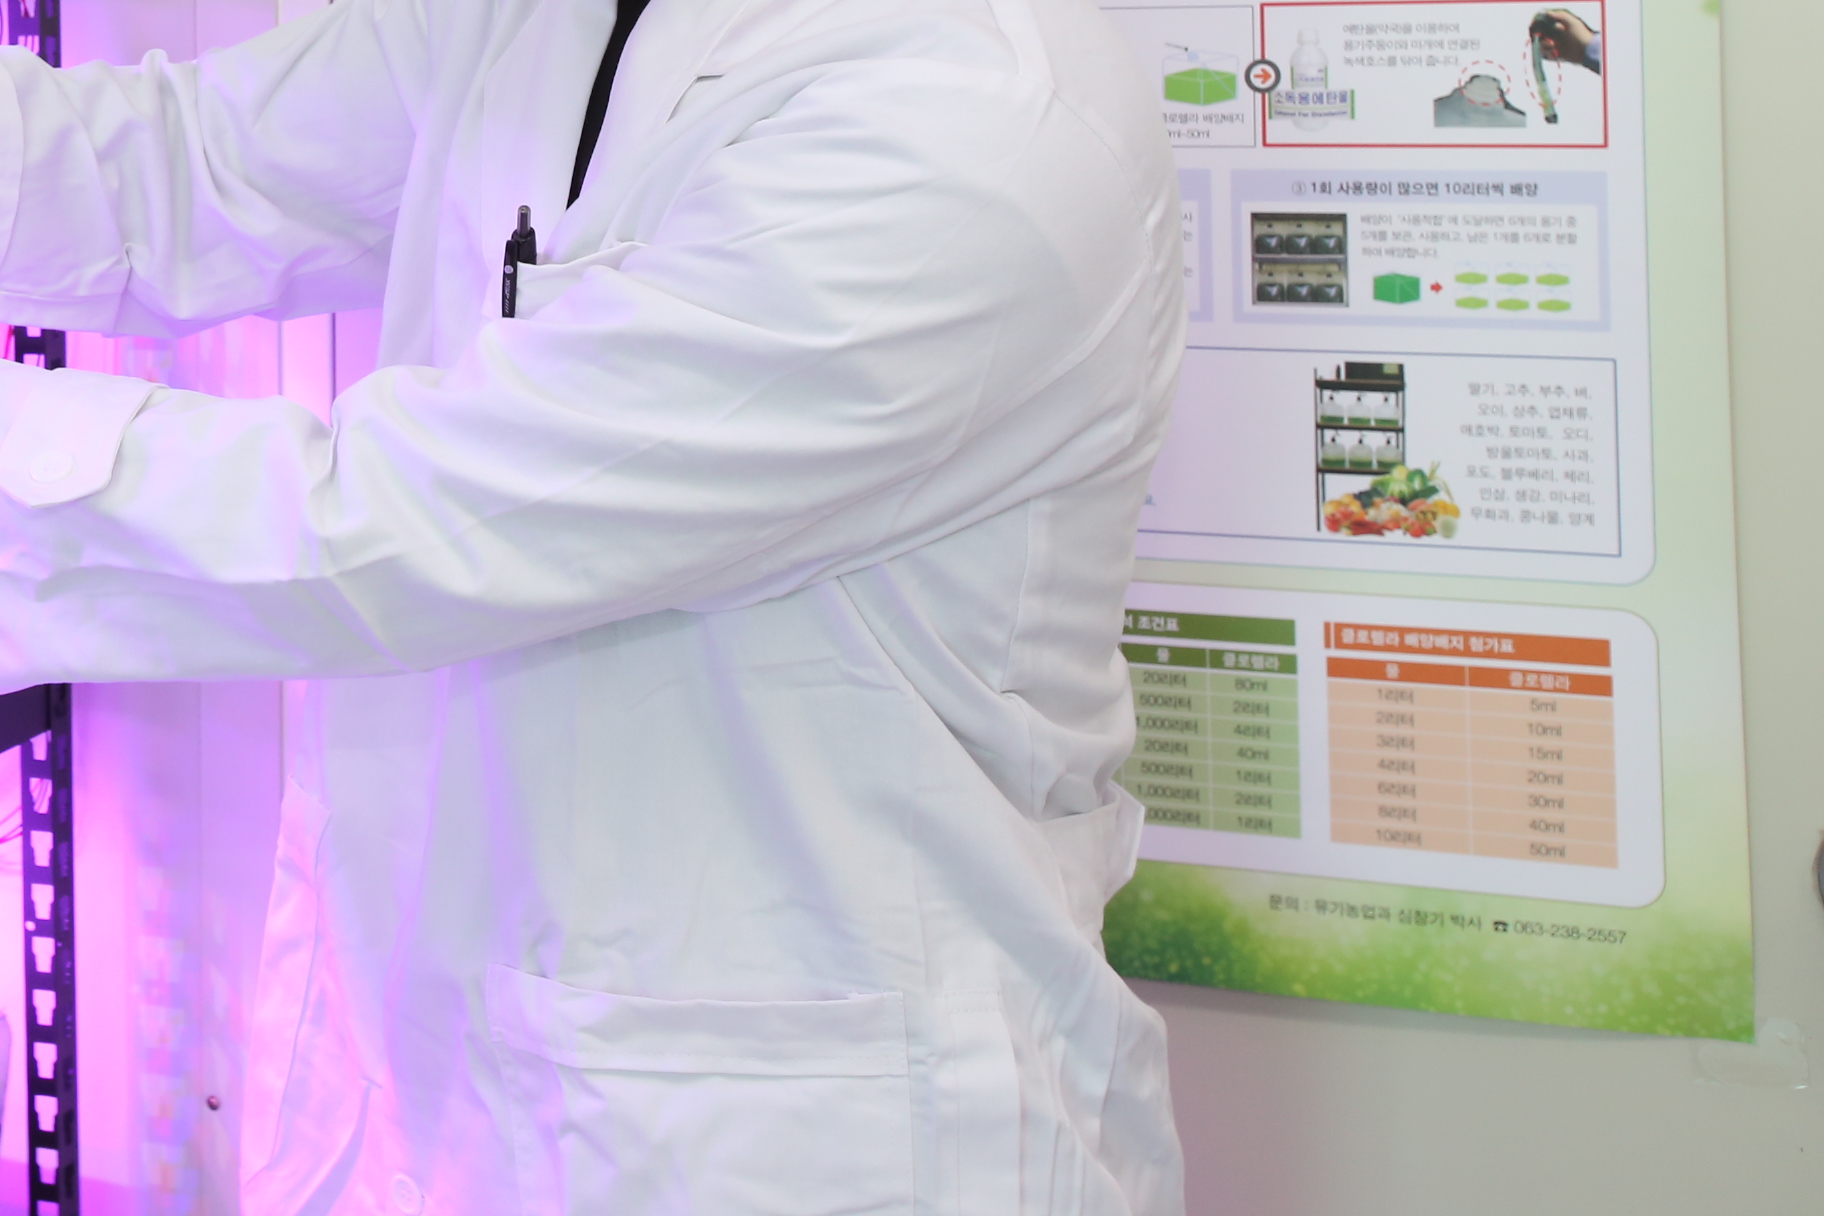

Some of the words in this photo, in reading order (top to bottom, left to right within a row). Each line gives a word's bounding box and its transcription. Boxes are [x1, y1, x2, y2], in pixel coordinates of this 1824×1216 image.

[1312, 182, 1331, 195] 1회
[1337, 181, 1392, 195] 사용량이
[1510, 183, 1538, 197] 배양
[1530, 699, 1557, 713] 5ml
[1527, 723, 1562, 737] 10ml
[1528, 747, 1563, 762] 15ml
[1527, 770, 1563, 785] 20ml
[1527, 794, 1564, 809] 30ml
[1529, 818, 1565, 833] 40ml
[1529, 843, 1566, 858] 50ml
[1268, 893, 1300, 913] 문의
[1314, 899, 1391, 923] 유기농업과
[1451, 914, 1481, 932] 박사
[1514, 921, 1627, 945] 063-238-2557
